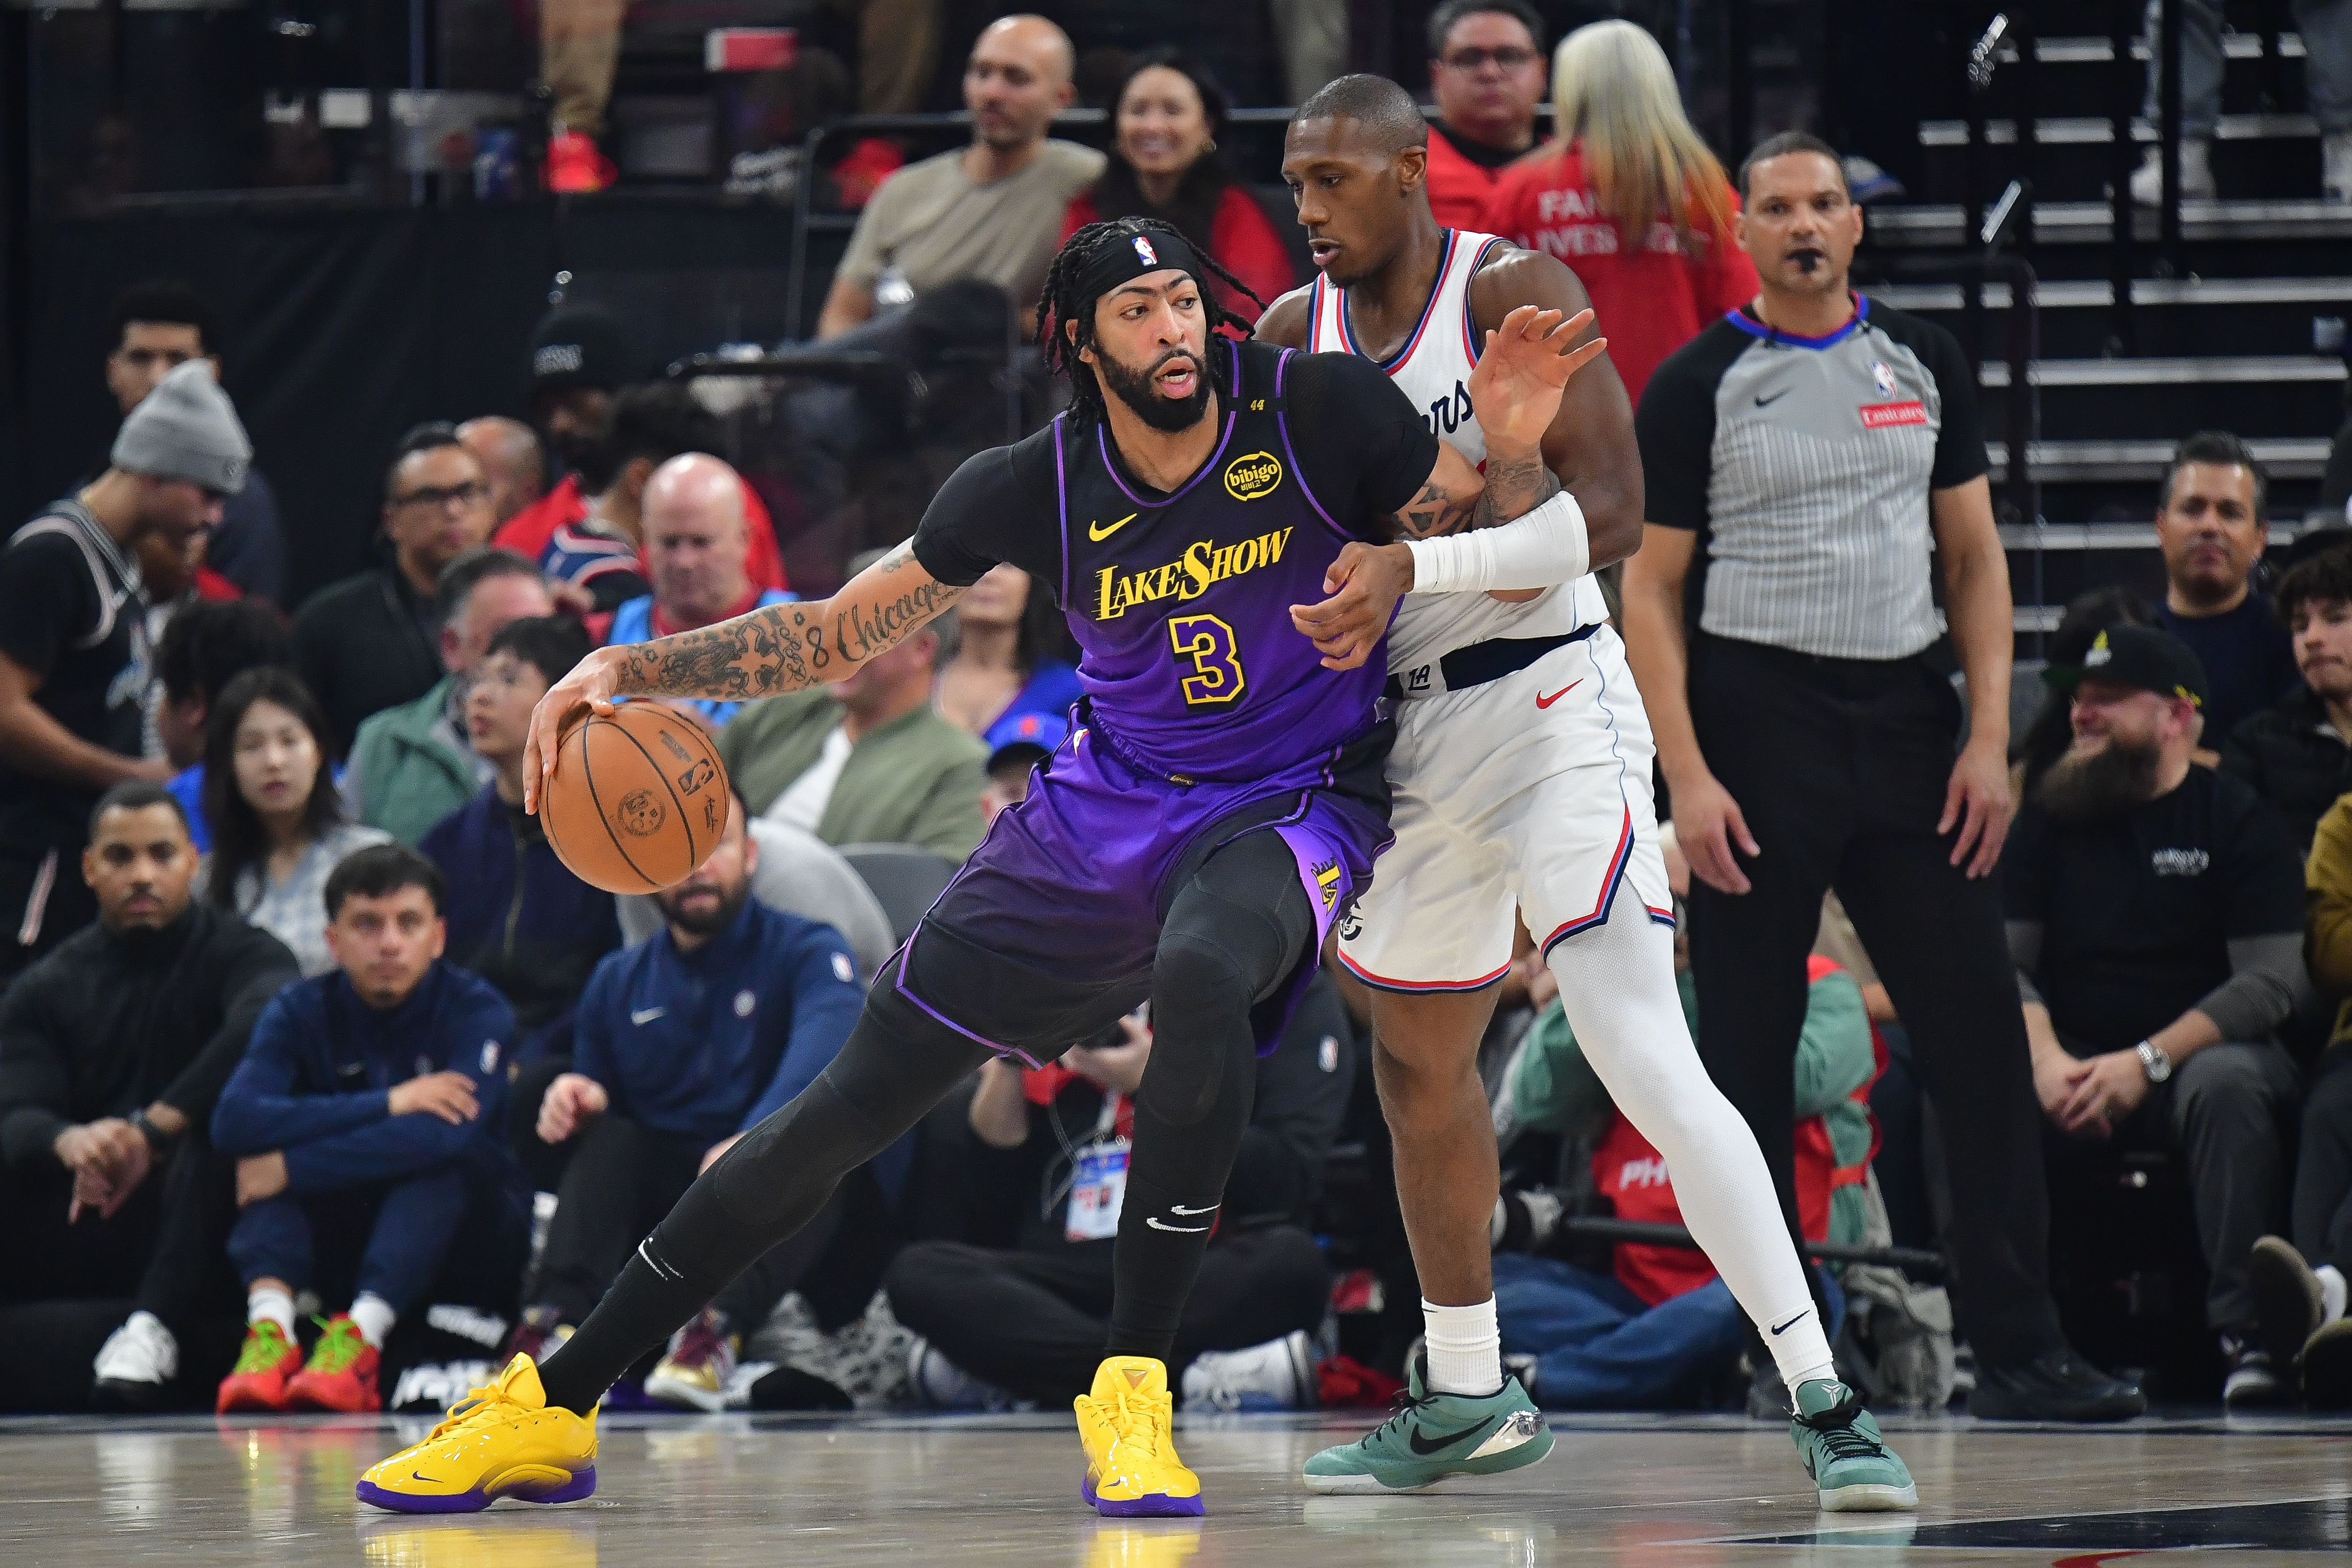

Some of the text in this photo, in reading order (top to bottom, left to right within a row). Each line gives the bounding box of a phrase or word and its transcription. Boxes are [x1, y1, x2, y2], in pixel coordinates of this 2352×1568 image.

[1250, 399, 1265, 410] 44
[1421, 379, 1474, 436] rs
[1229, 463, 1278, 487] bibigo
[1241, 479, 1262, 491] 비비고
[1168, 614, 1244, 704] 3
[1408, 664, 1431, 691] LA
